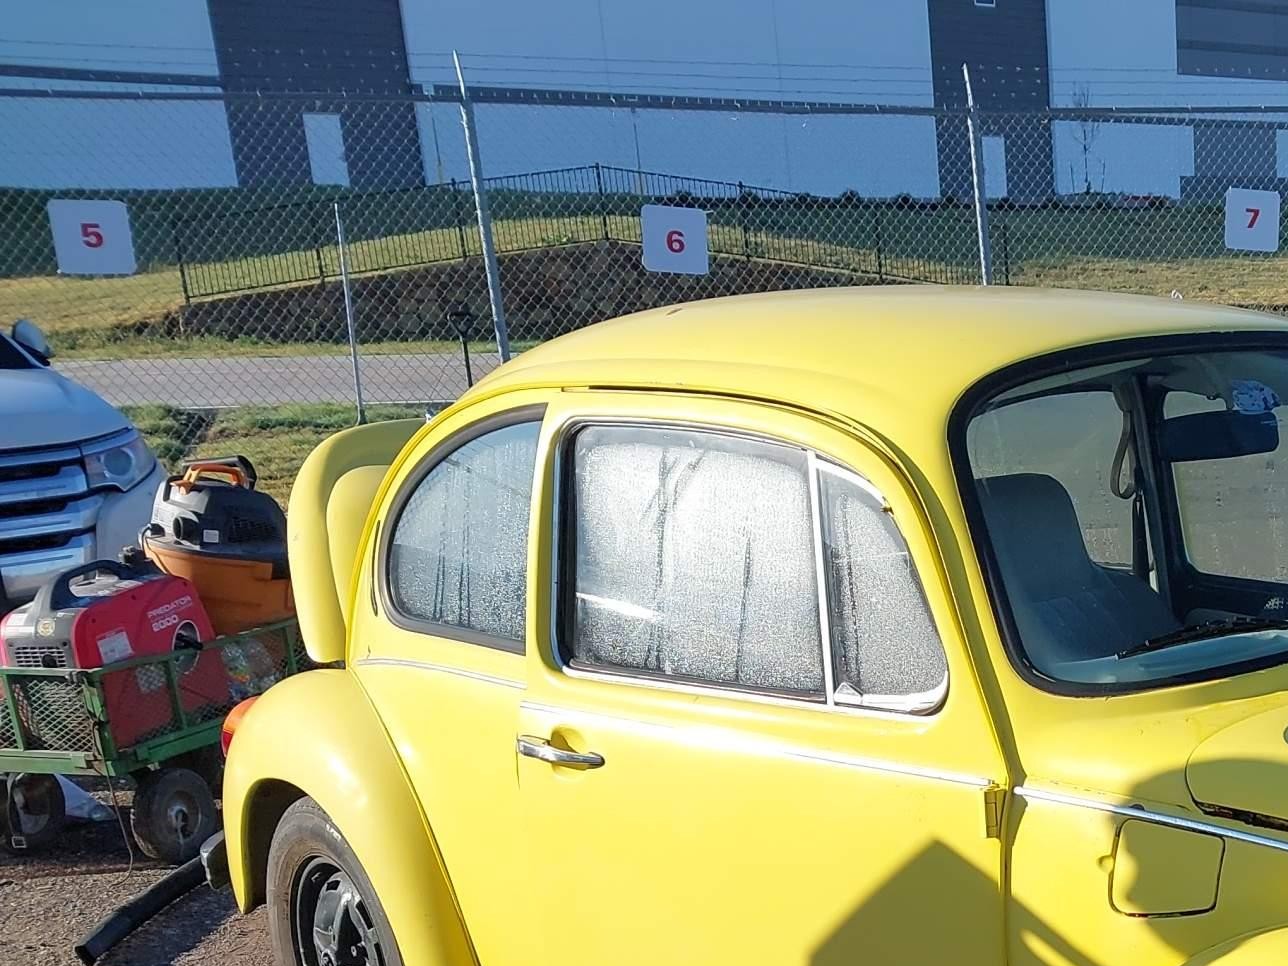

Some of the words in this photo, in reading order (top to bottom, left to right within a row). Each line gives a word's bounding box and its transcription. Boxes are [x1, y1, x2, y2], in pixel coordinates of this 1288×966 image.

[1245, 207, 1261, 229] 7
[80, 222, 104, 248] 5
[666, 230, 686, 254] 6
[146, 595, 193, 618] PREDATOR
